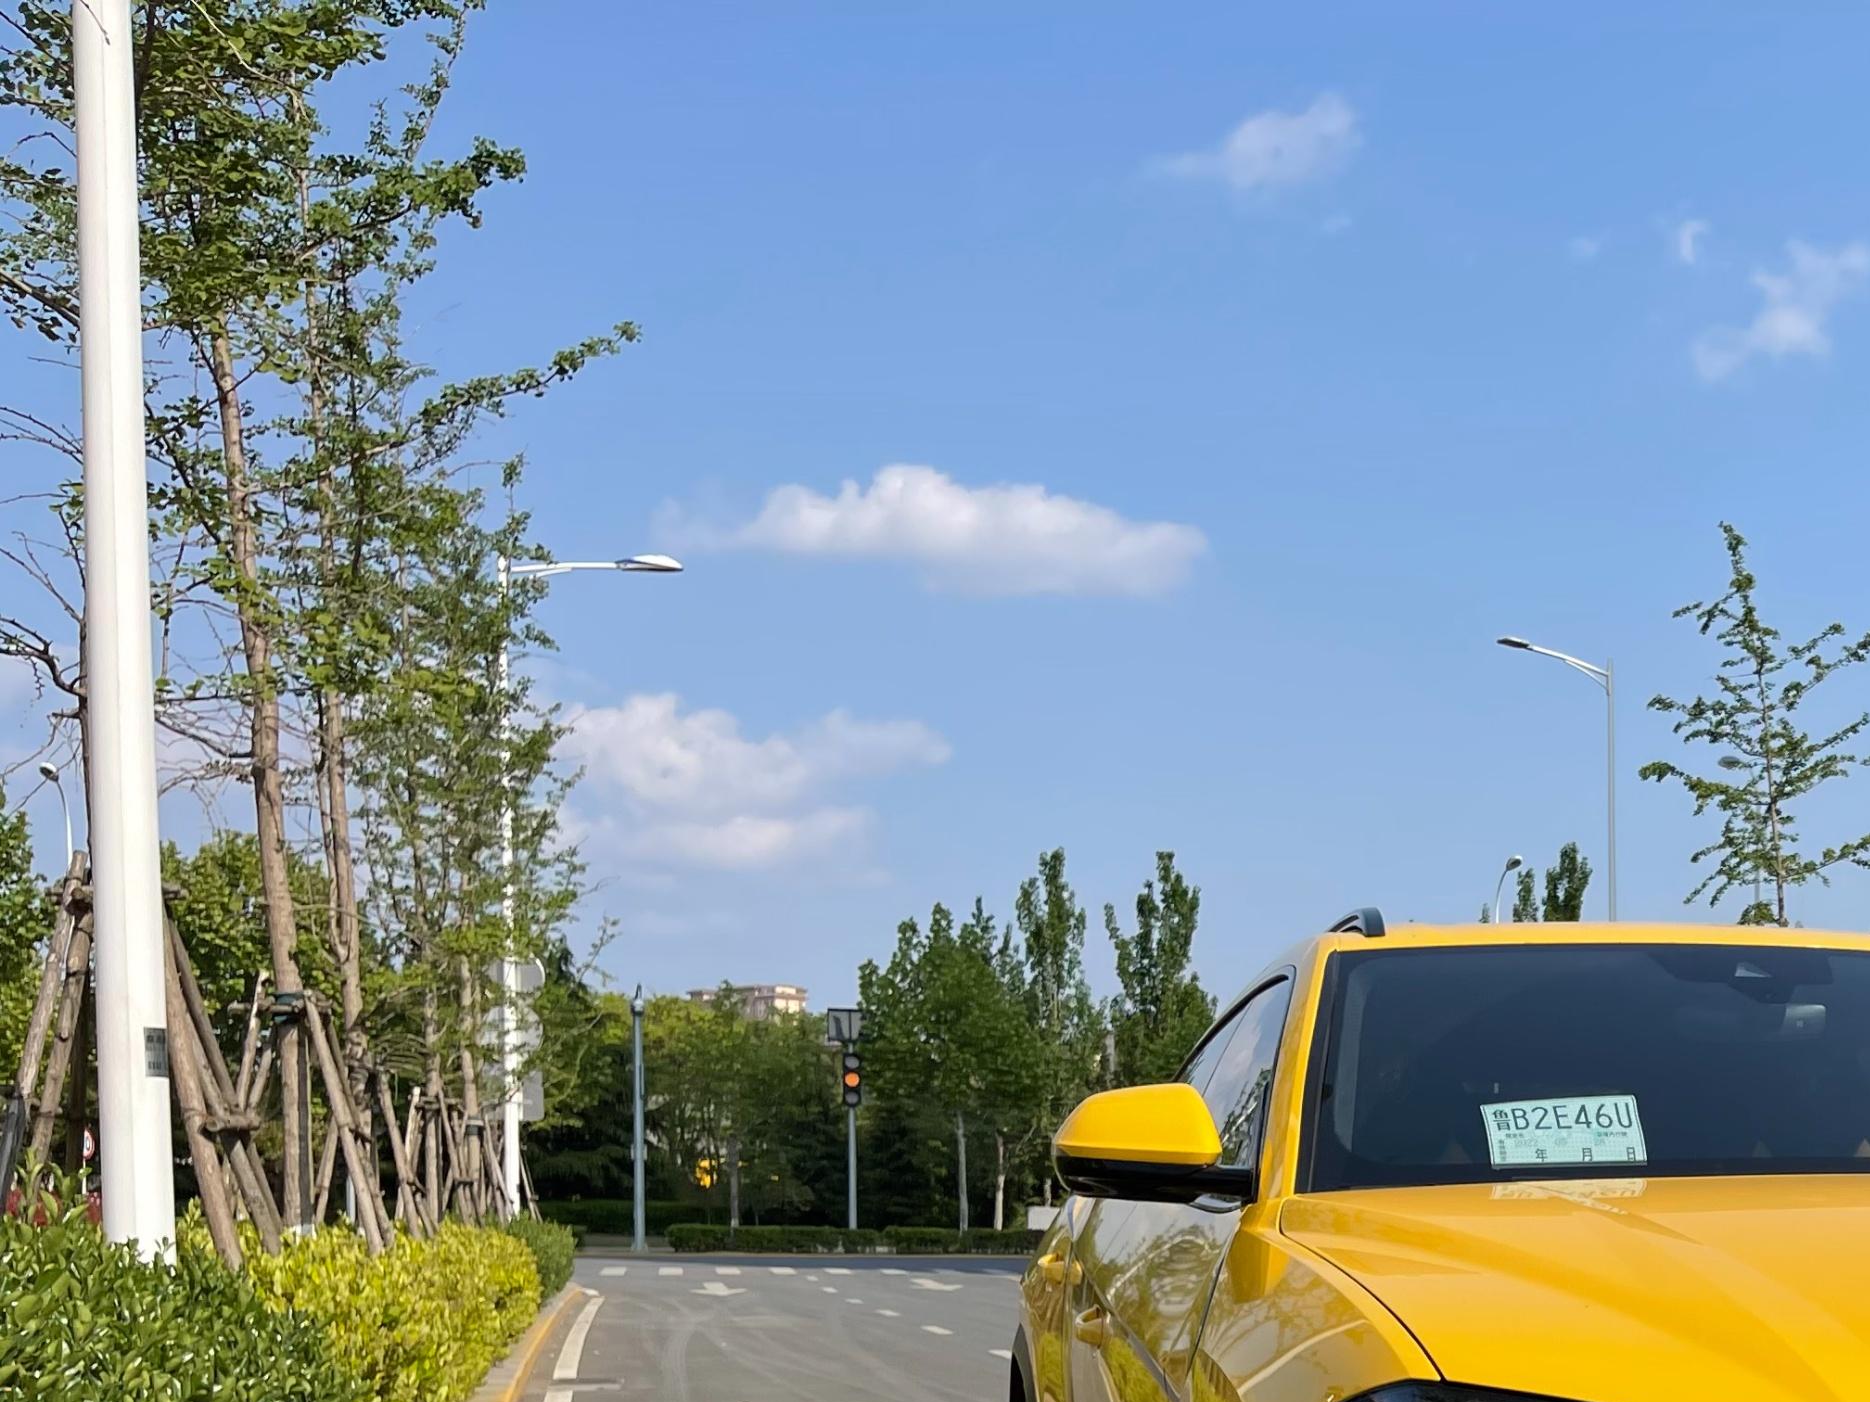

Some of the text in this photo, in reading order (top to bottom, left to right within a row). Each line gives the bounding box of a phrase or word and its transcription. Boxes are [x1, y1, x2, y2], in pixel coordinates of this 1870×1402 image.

[1493, 1102, 1633, 1131] 鲁B2E46U
[1535, 1148, 1548, 1162] 年
[1582, 1147, 1593, 1161] 月
